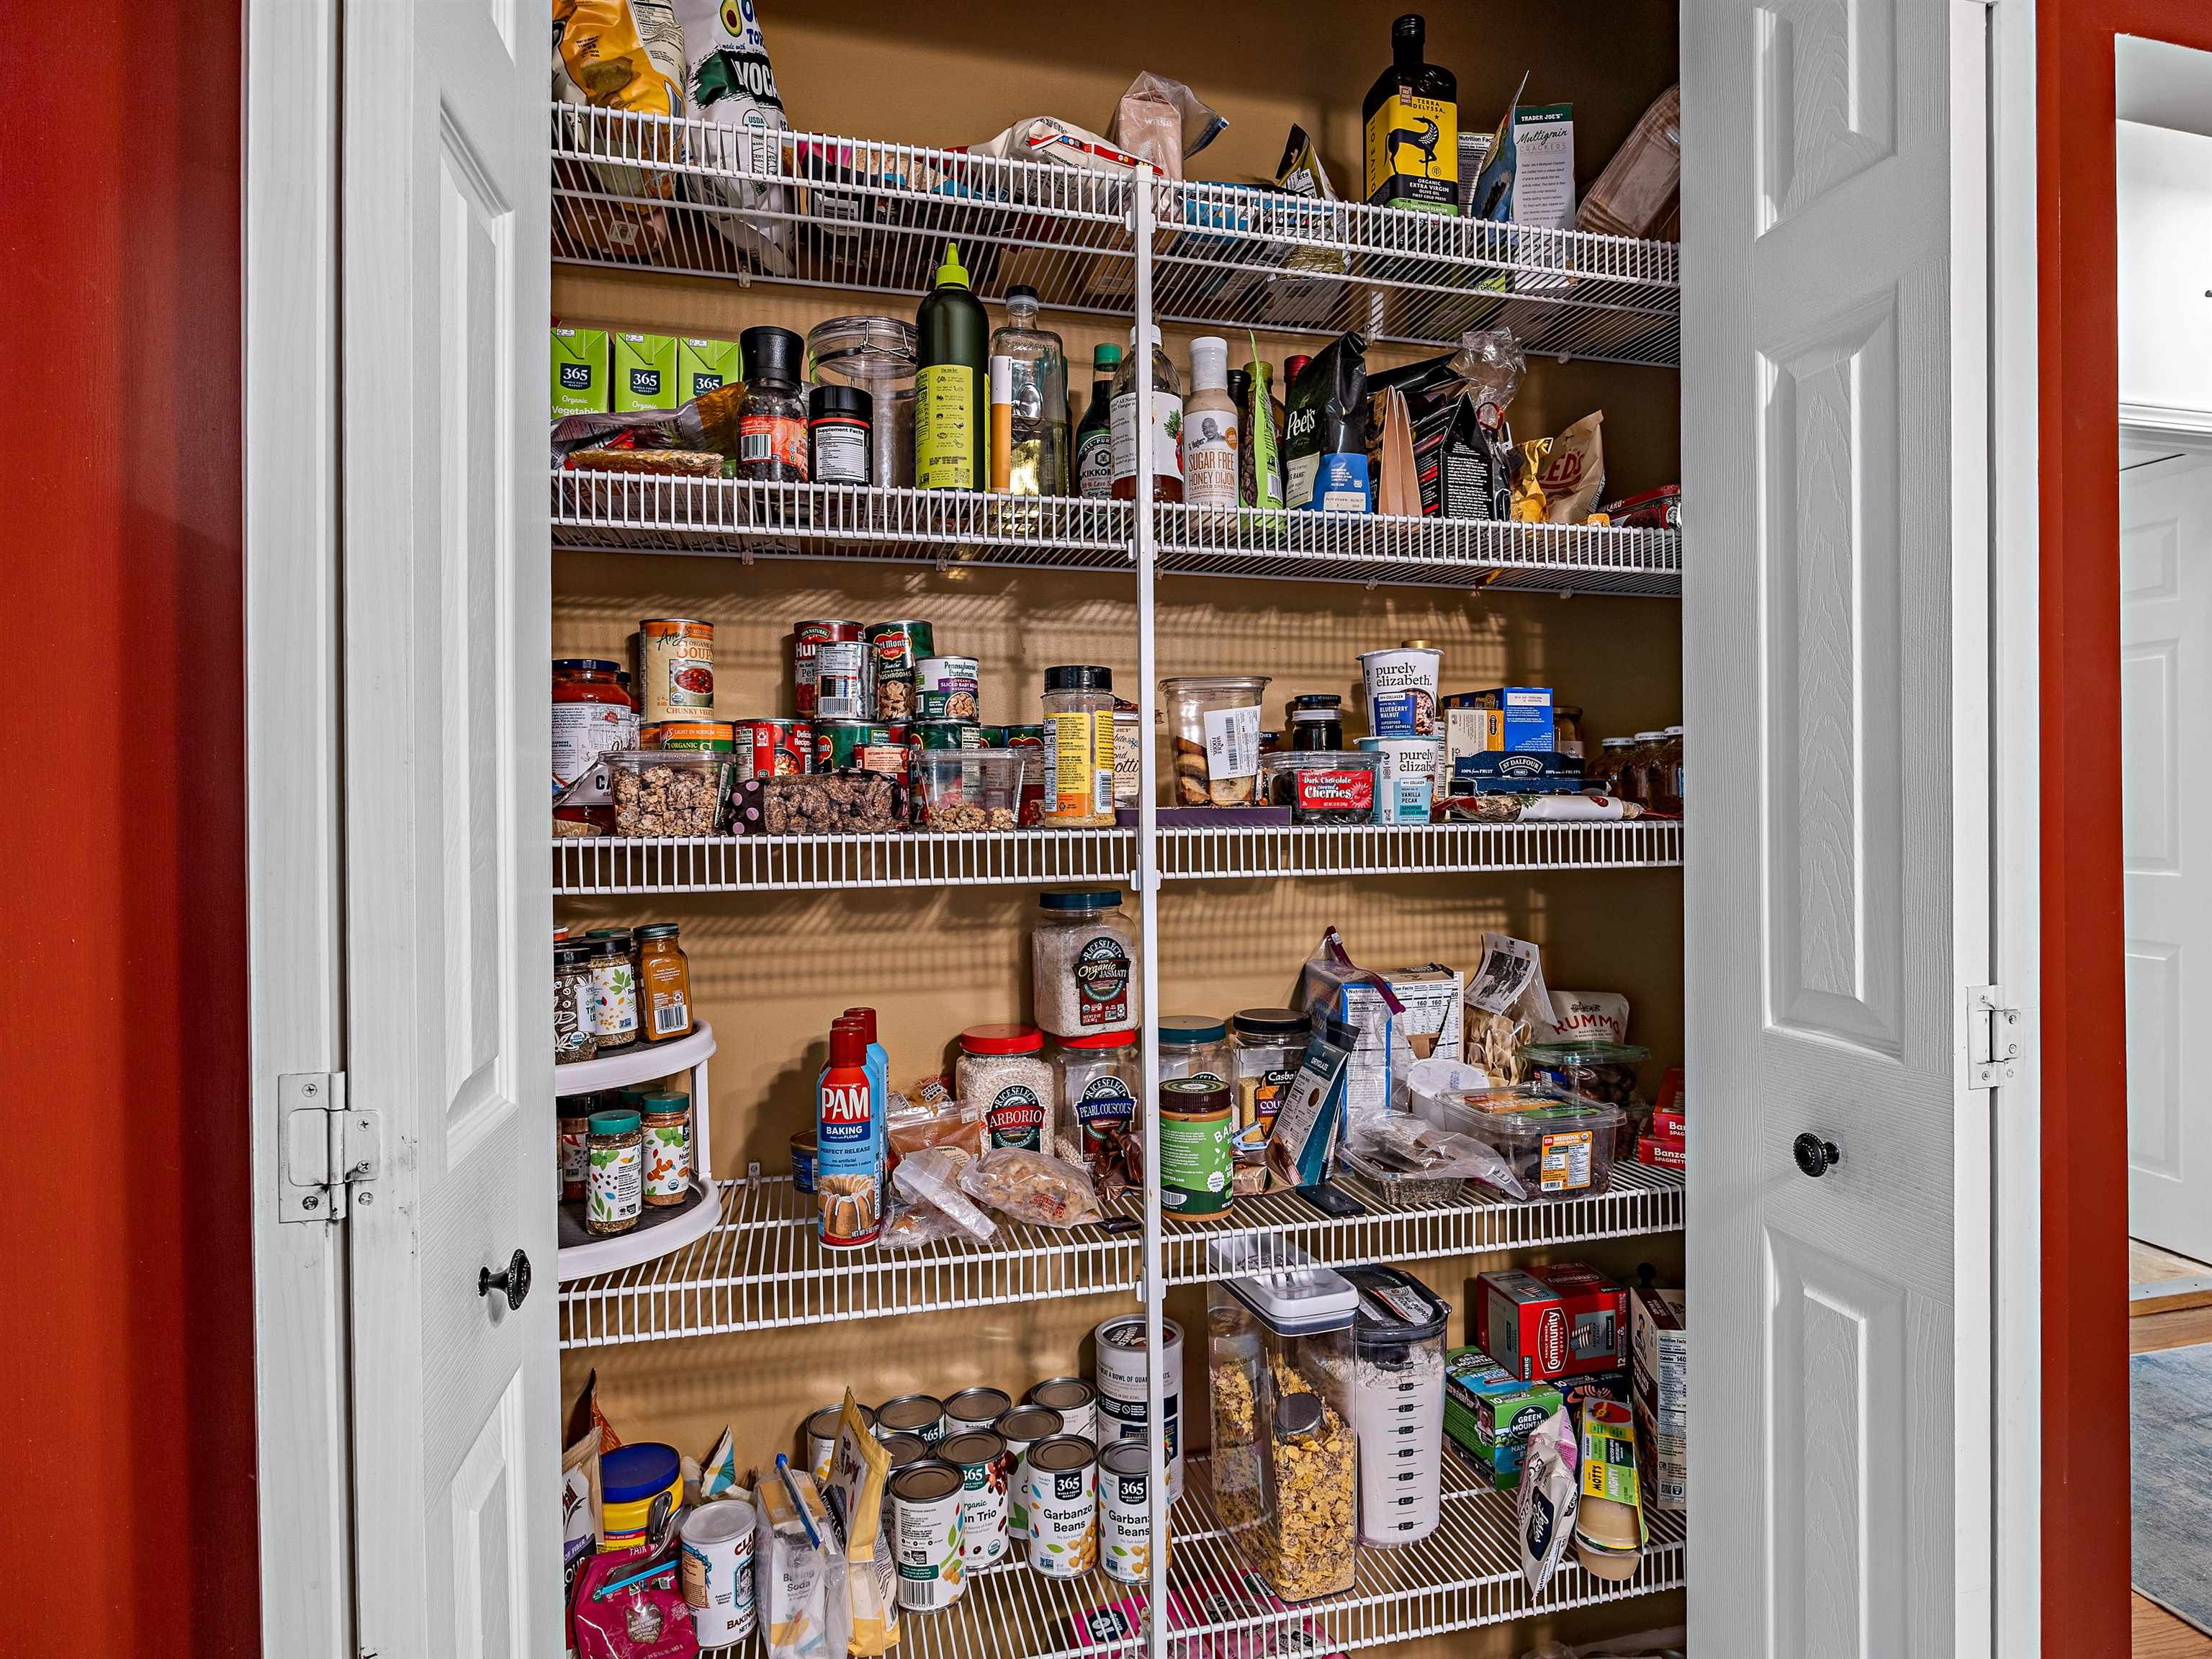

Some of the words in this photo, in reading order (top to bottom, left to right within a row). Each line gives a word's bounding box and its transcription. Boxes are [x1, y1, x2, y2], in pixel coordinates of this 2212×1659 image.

[1416, 98, 1440, 107] TERRA
[747, 116, 765, 125] USDA
[1516, 128, 1568, 145] Multigrain
[1519, 143, 1567, 152] CRACKERS
[1417, 178, 1442, 186] ORGANIC
[1429, 184, 1450, 193] VIRGIN
[562, 367, 588, 381] 365
[633, 373, 657, 387] 365
[696, 377, 719, 390] 365
[561, 395, 588, 404] Organic
[631, 400, 657, 409] Organic
[1285, 408, 1316, 441] Peet's
[1084, 438, 1111, 452] ALL-PUR
[1188, 451, 1215, 472] SUGAR
[1218, 451, 1235, 472] FREE
[1081, 468, 1111, 479] KIKKO
[1188, 472, 1214, 487] HONEY
[1215, 472, 1236, 486] DIJON
[656, 625, 692, 652] Amy's
[809, 628, 828, 637] NATURAL
[886, 638, 910, 648] Monte
[944, 661, 976, 670] Pennsylvania
[1375, 662, 1416, 678] purely
[745, 745, 752, 753] 30
[1113, 751, 1128, 760] ond
[1399, 748, 1434, 763] purely
[1114, 759, 1140, 774] otti
[1510, 757, 1539, 770] DALFOUR
[1320, 776, 1352, 785] Chocolate
[1304, 785, 1353, 799] Cherries
[1082, 939, 1123, 959] RICESELECT
[1078, 961, 1116, 981] Organic
[1099, 969, 1128, 979] JASMATI
[1552, 1014, 1620, 1036] RUMMO
[1310, 1056, 1330, 1072] DRYGLAZE
[1085, 1078, 1126, 1099] RICESELECT
[996, 1086, 1036, 1106] RICESELECT
[820, 1086, 870, 1121] PAM
[1080, 1105, 1100, 1118] PEARL
[1100, 1102, 1132, 1116] COUSCOUS
[989, 1110, 1043, 1128] ARBORIO
[826, 1125, 863, 1136] BAKING
[1213, 1121, 1233, 1143] BAR
[844, 1146, 871, 1154] RELEASE
[1653, 1147, 1686, 1159] Banza
[1118, 1326, 1138, 1347] QUAKER
[1547, 1311, 1560, 1370] Community
[1458, 1354, 1489, 1363] GREEN
[1617, 1357, 1626, 1367] 12
[1112, 1372, 1125, 1382] BOWL
[1553, 1380, 1568, 1388] 10
[1517, 1413, 1542, 1424] GREEN
[921, 1427, 939, 1441] 365
[963, 1468, 983, 1481] 365
[1592, 1465, 1602, 1491] MOTT'S
[1608, 1467, 1619, 1496] MIGHTY
[1056, 1476, 1080, 1491] 365
[1120, 1481, 1144, 1495] 365
[963, 1499, 987, 1511] rganic
[1043, 1503, 1093, 1521] Garbanzo
[976, 1509, 997, 1521] Trio
[1108, 1509, 1150, 1525] Garban
[1053, 1520, 1086, 1533] Beans
[1118, 1524, 1150, 1537] Beans
[564, 1551, 571, 1561] OF
[571, 1538, 586, 1555] FIBER
[786, 1581, 811, 1592] Soda
[727, 1609, 755, 1630] BAKING
[739, 1624, 749, 1634] NET
